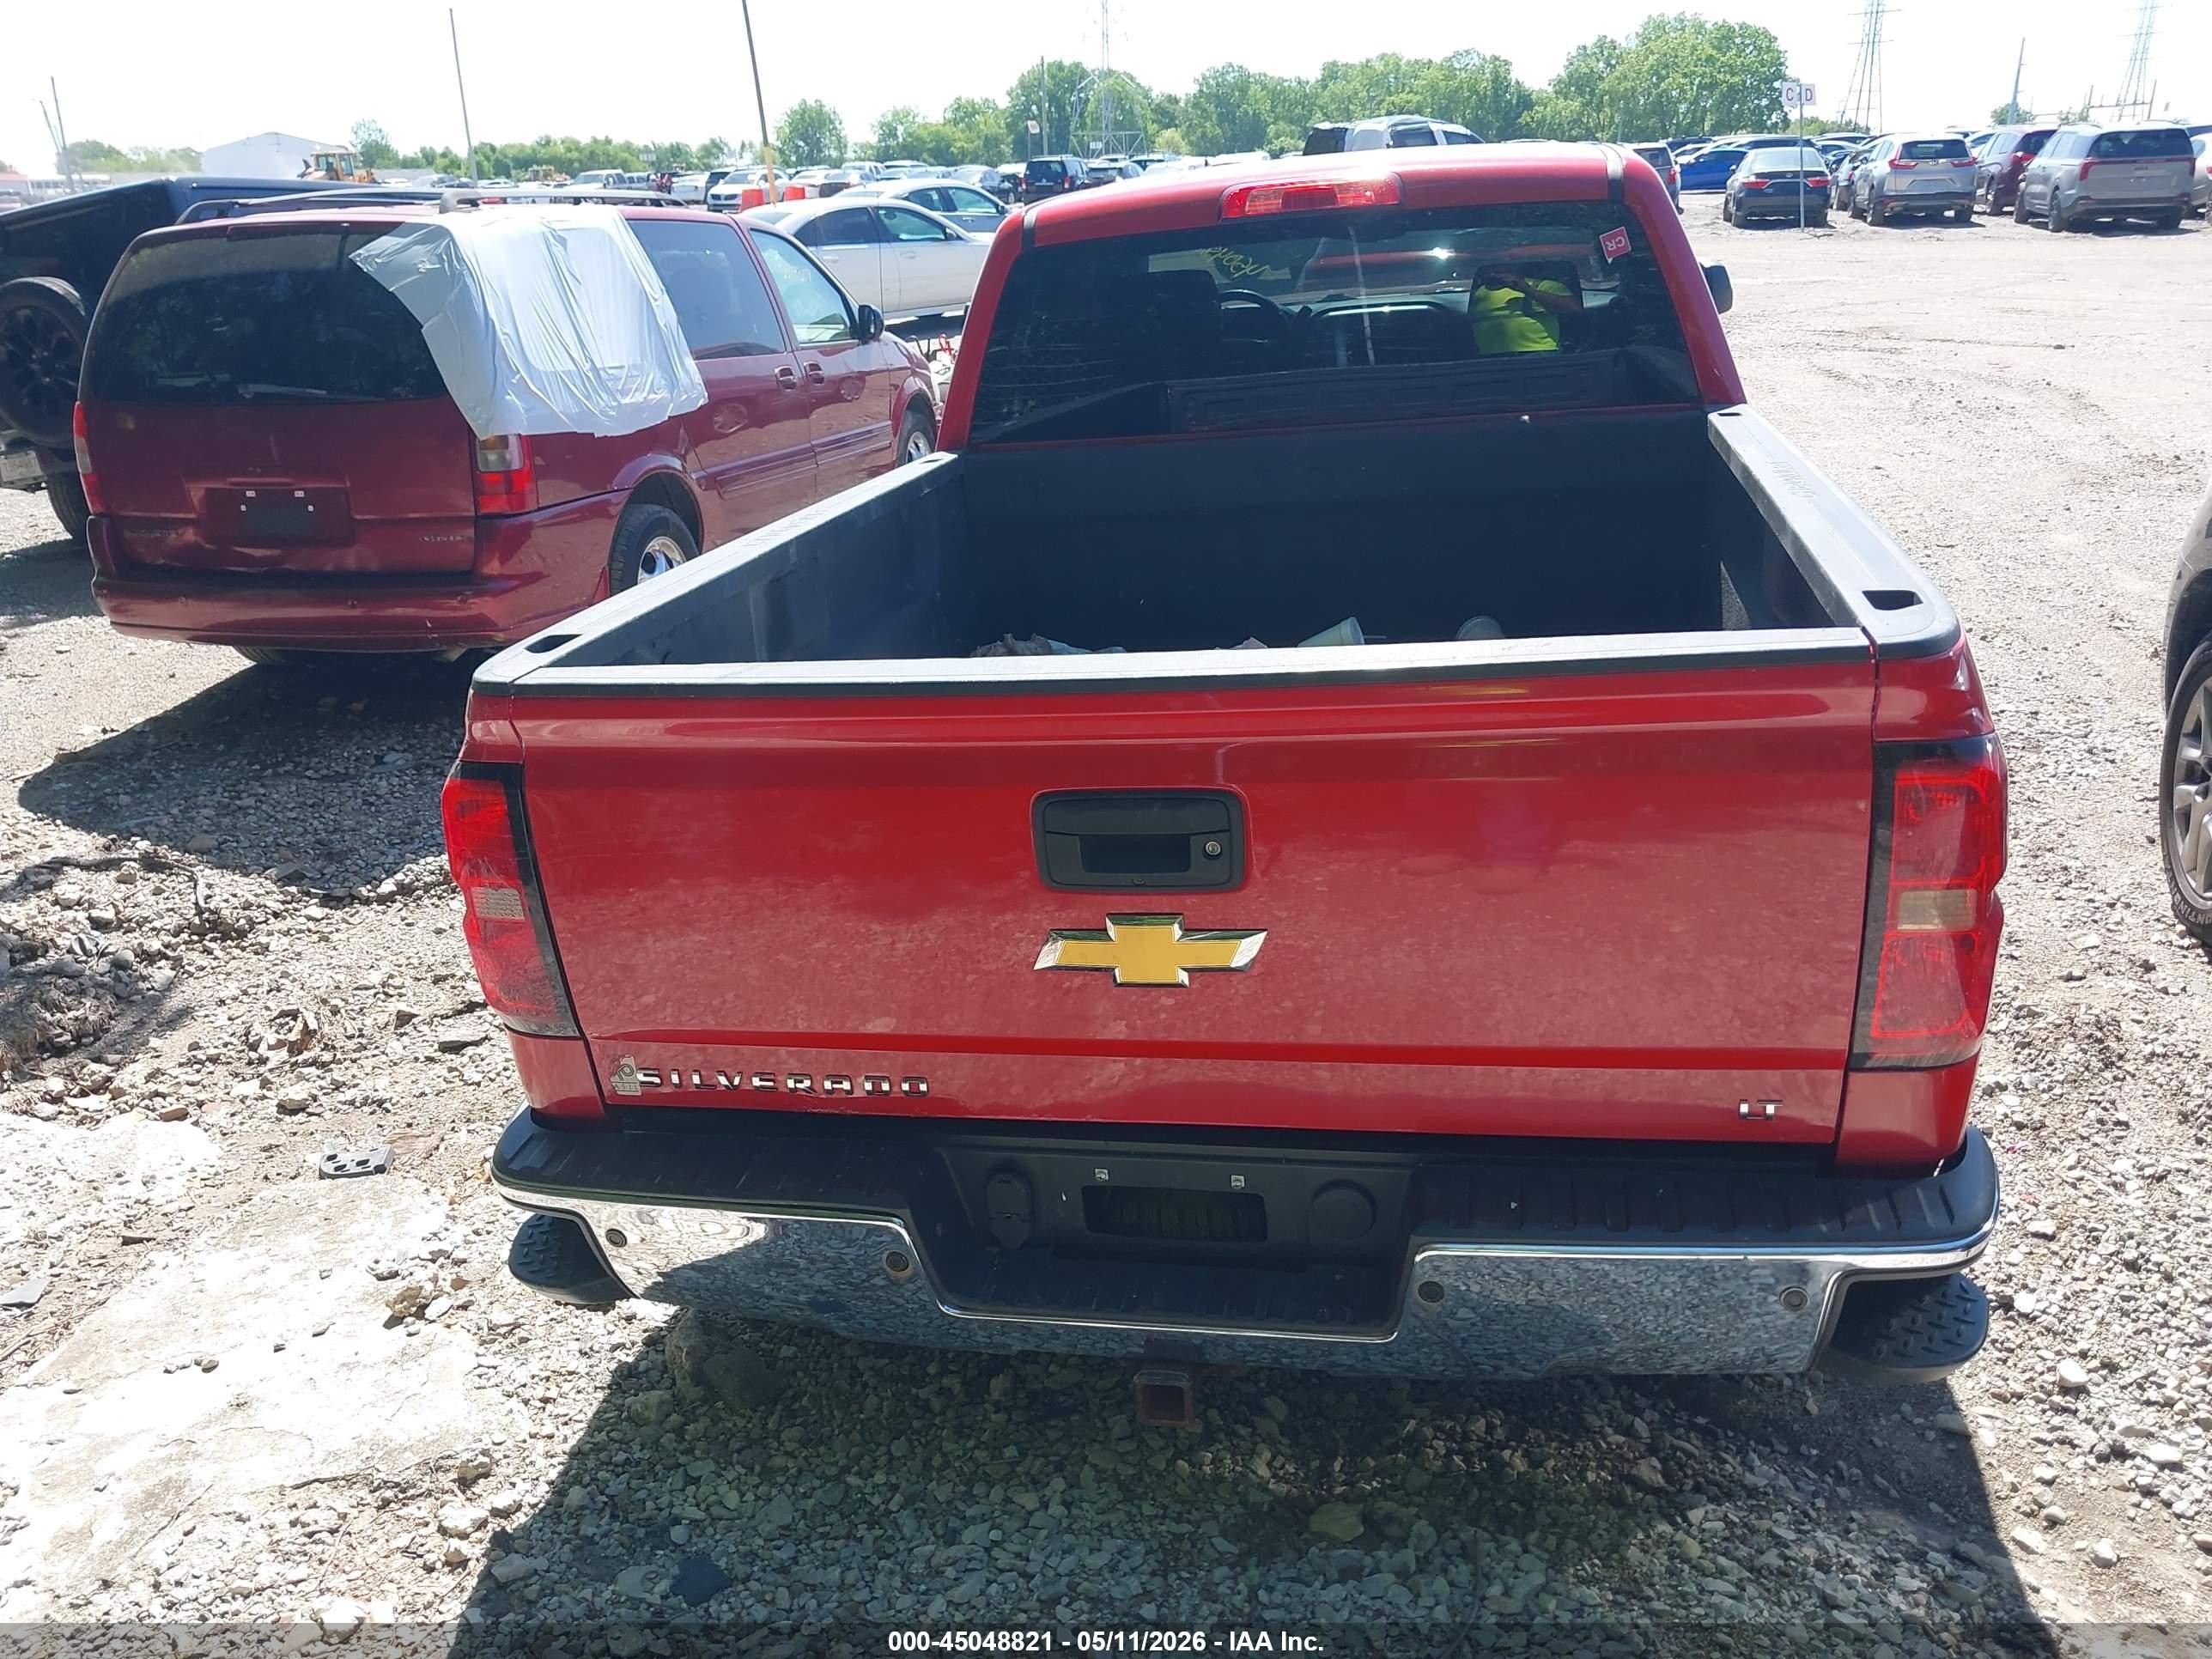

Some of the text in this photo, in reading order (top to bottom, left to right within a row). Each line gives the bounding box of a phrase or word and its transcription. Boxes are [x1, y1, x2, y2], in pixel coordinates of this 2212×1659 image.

[1786, 88, 1813, 101] C D
[1605, 236, 1626, 251] CR
[635, 1066, 930, 1098] SILVERADO
[1738, 1098, 1784, 1121] LT
